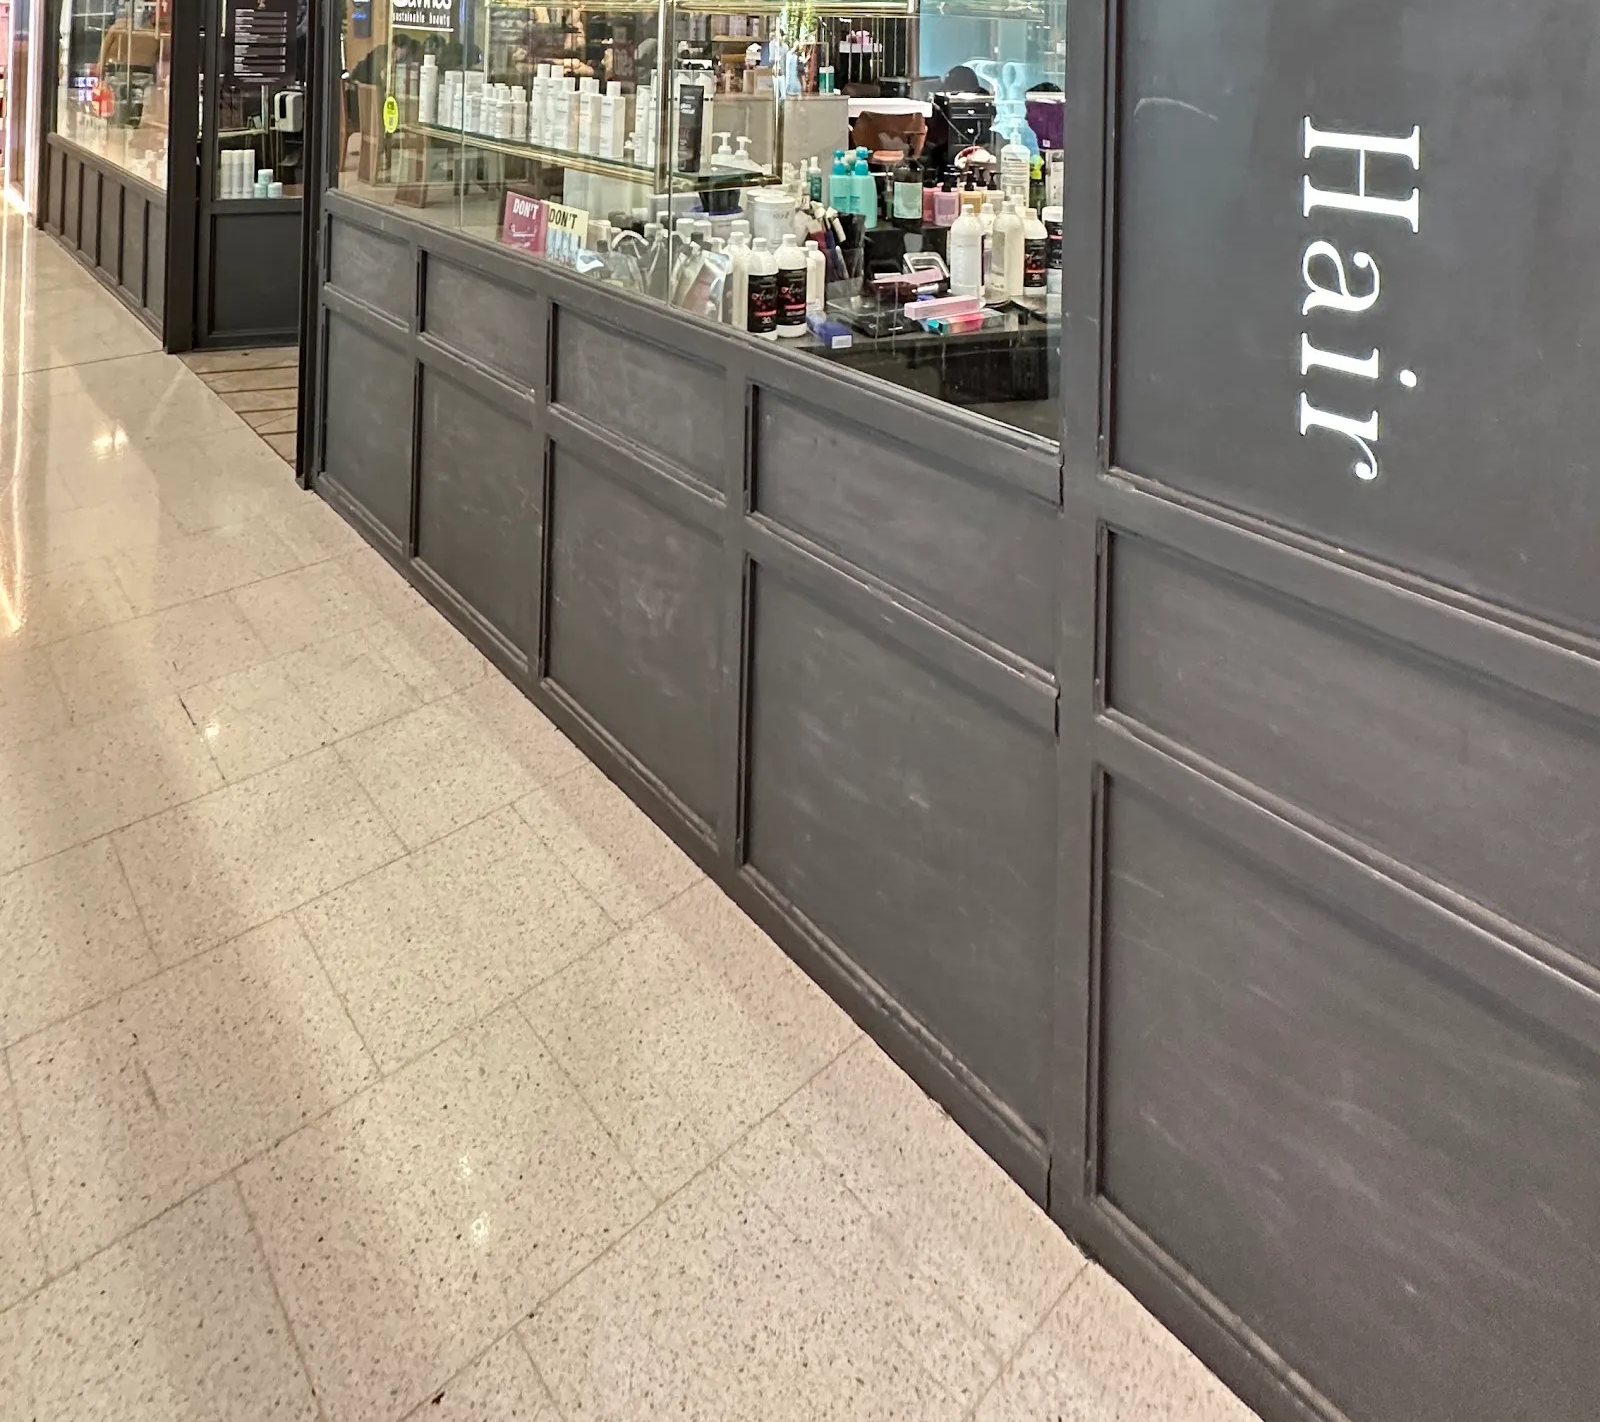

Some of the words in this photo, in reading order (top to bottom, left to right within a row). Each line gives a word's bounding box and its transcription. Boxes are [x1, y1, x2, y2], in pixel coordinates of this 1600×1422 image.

[429, 12, 451, 27] beauty
[512, 198, 540, 220] DON'T
[548, 208, 578, 229] DON'T
[1300, 116, 1420, 481] Hair
